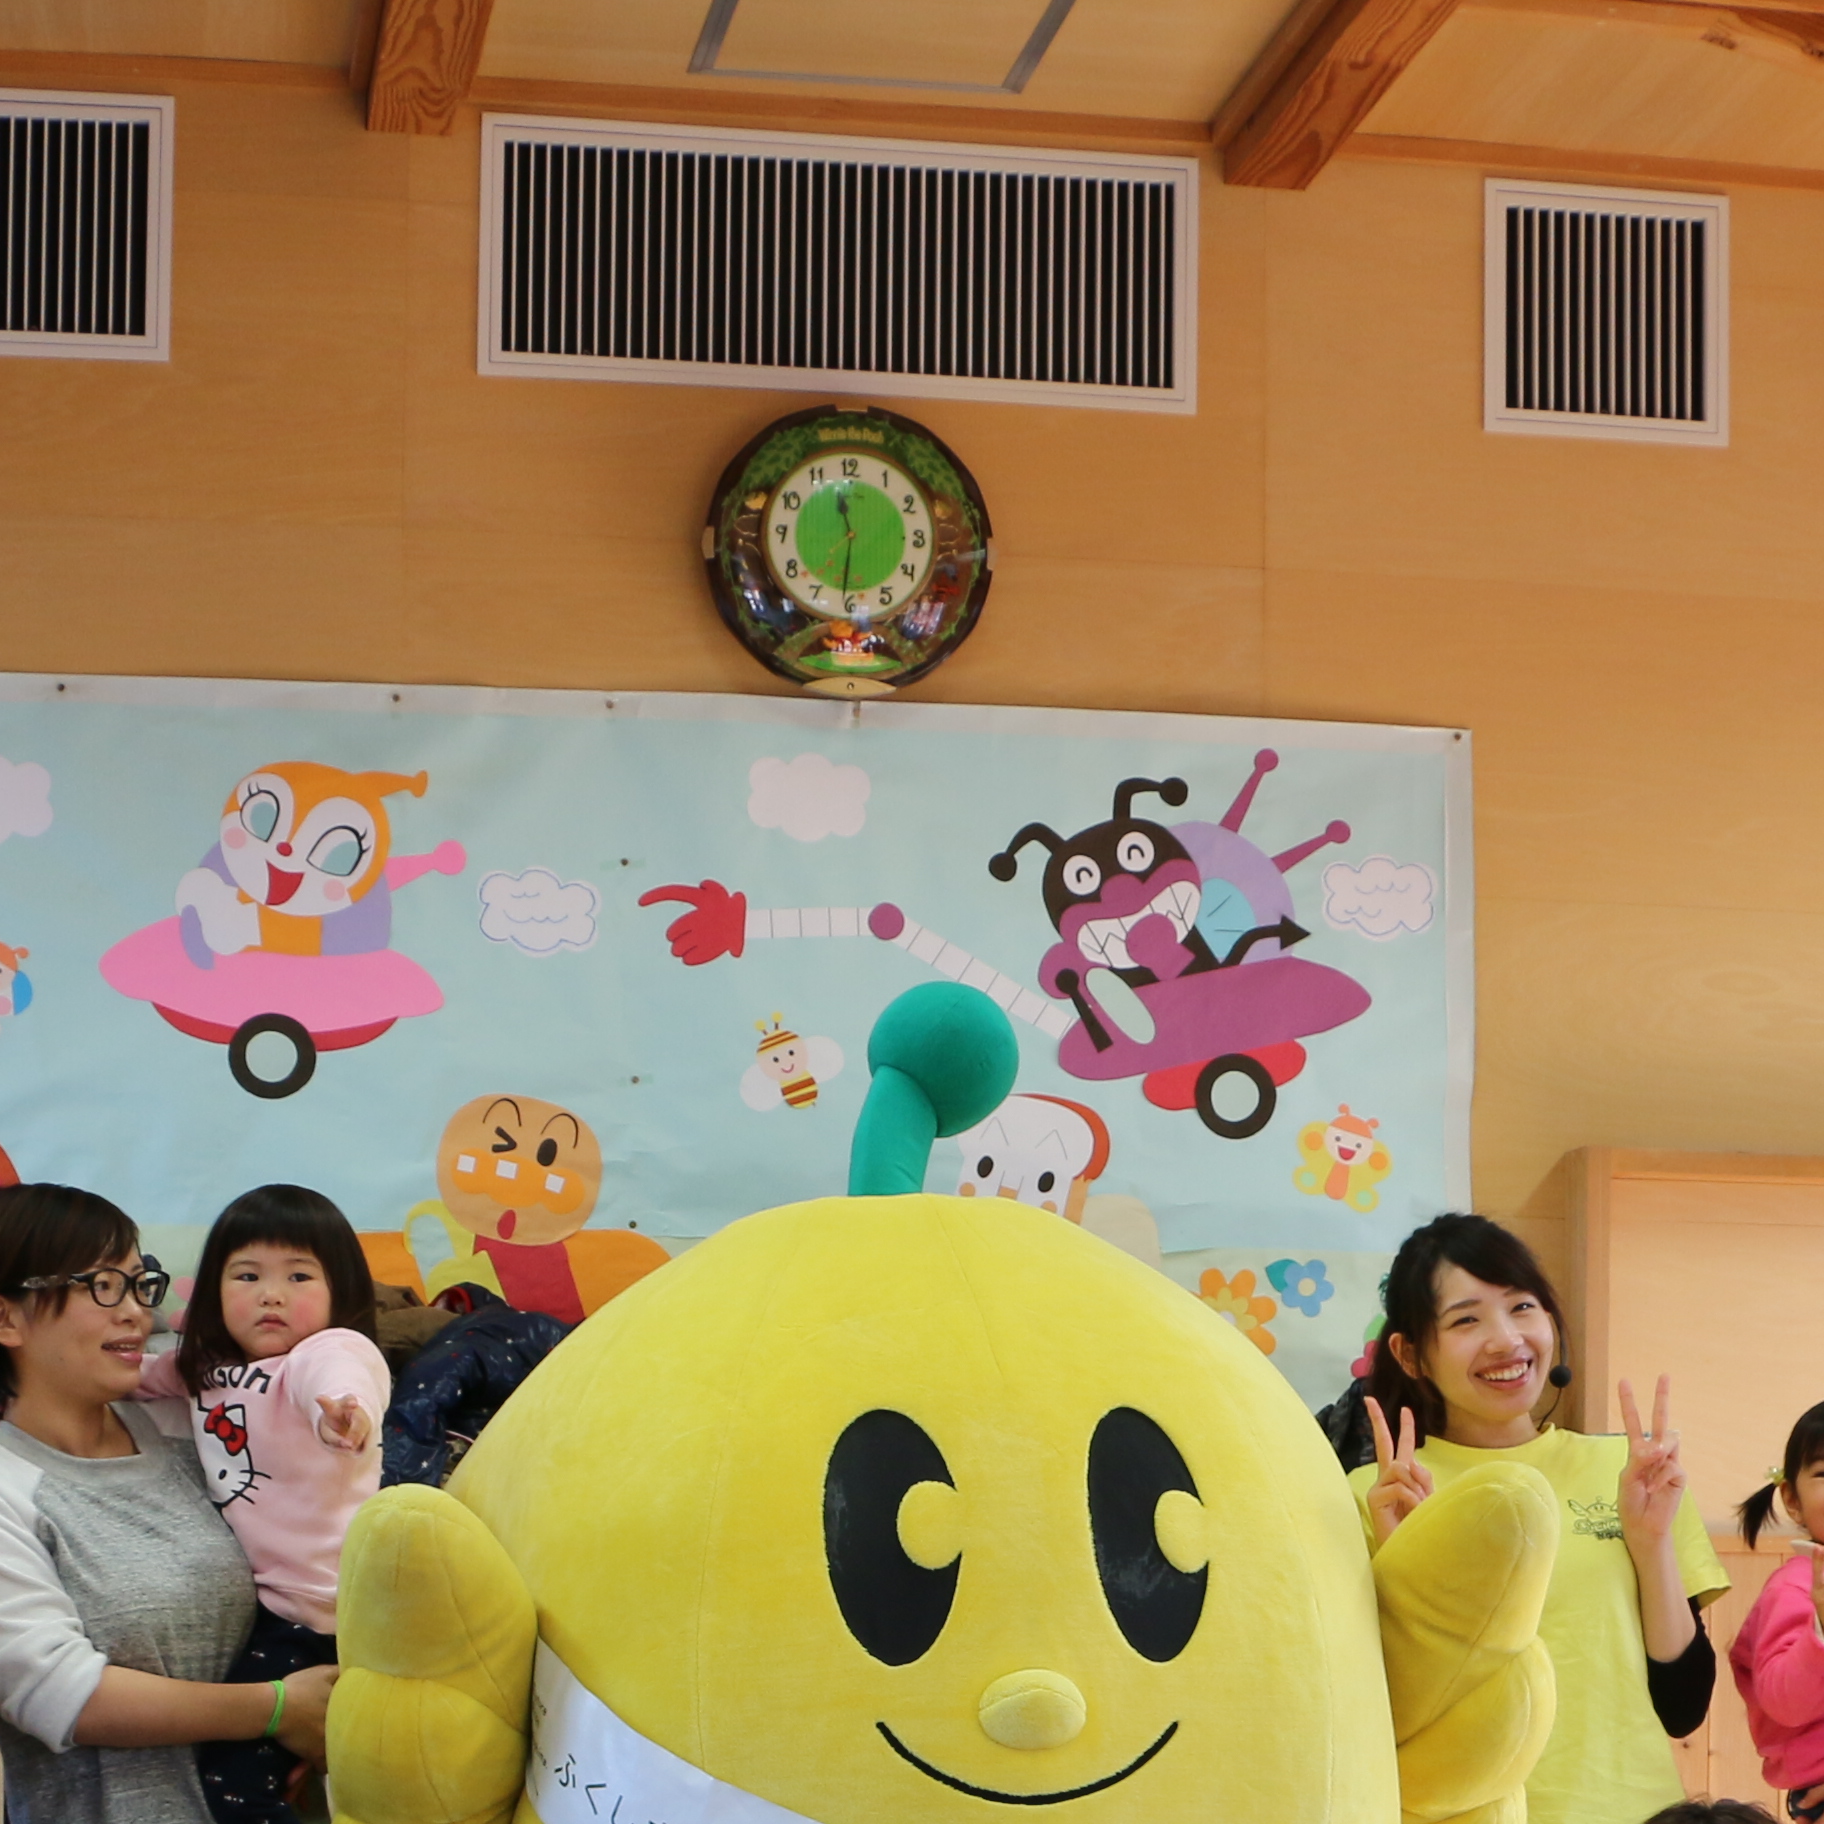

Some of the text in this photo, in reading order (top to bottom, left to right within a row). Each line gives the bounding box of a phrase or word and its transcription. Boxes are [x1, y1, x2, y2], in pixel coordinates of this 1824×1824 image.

[810, 467, 823, 485] 11
[842, 458, 860, 477] 12
[882, 470, 888, 488] 1
[782, 491, 800, 510] 10
[903, 495, 916, 514] 2
[776, 524, 787, 543] 9
[913, 530, 925, 548] 3
[786, 559, 797, 578] 8
[901, 563, 915, 582] 4
[809, 585, 823, 600] 7
[880, 586, 893, 605] 5
[844, 595, 856, 613] 6
